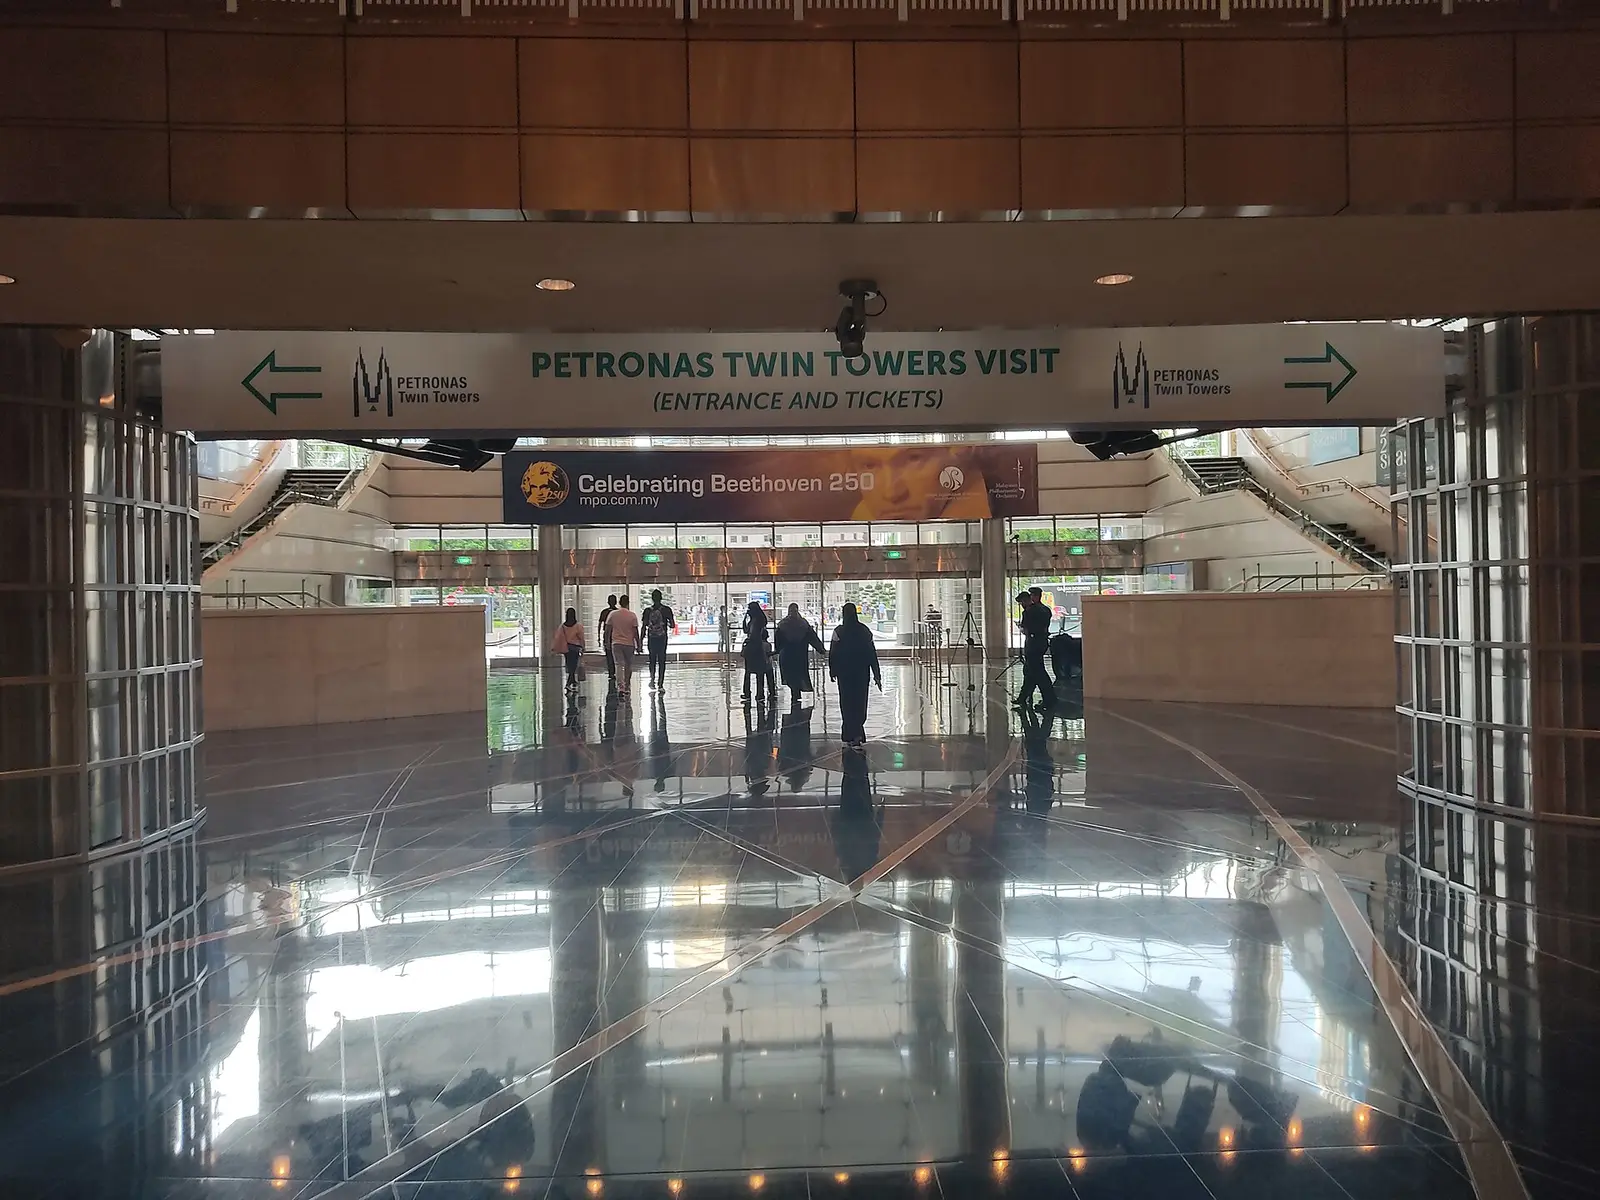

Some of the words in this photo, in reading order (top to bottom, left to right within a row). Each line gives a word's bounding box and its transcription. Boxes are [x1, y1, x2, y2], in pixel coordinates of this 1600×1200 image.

[532, 352, 715, 378] PETRONAS
[723, 351, 814, 377] TWIN
[824, 350, 967, 376] TOWERS
[974, 348, 1060, 375] VISIT
[1153, 369, 1220, 382] PETRONAS
[397, 376, 468, 389] PETRONAS
[1154, 383, 1183, 395] Twin
[1187, 382, 1231, 395] Towers
[398, 391, 429, 403] Twin
[433, 390, 480, 403] Towers
[653, 391, 784, 412] (ENTRANCE
[788, 391, 838, 410] AND
[845, 389, 944, 410] TICKETS)
[578, 474, 704, 498] Celebrating
[710, 474, 823, 493] Beethoven
[829, 472, 875, 491] 250
[579, 496, 660, 508] mpo.com.my
